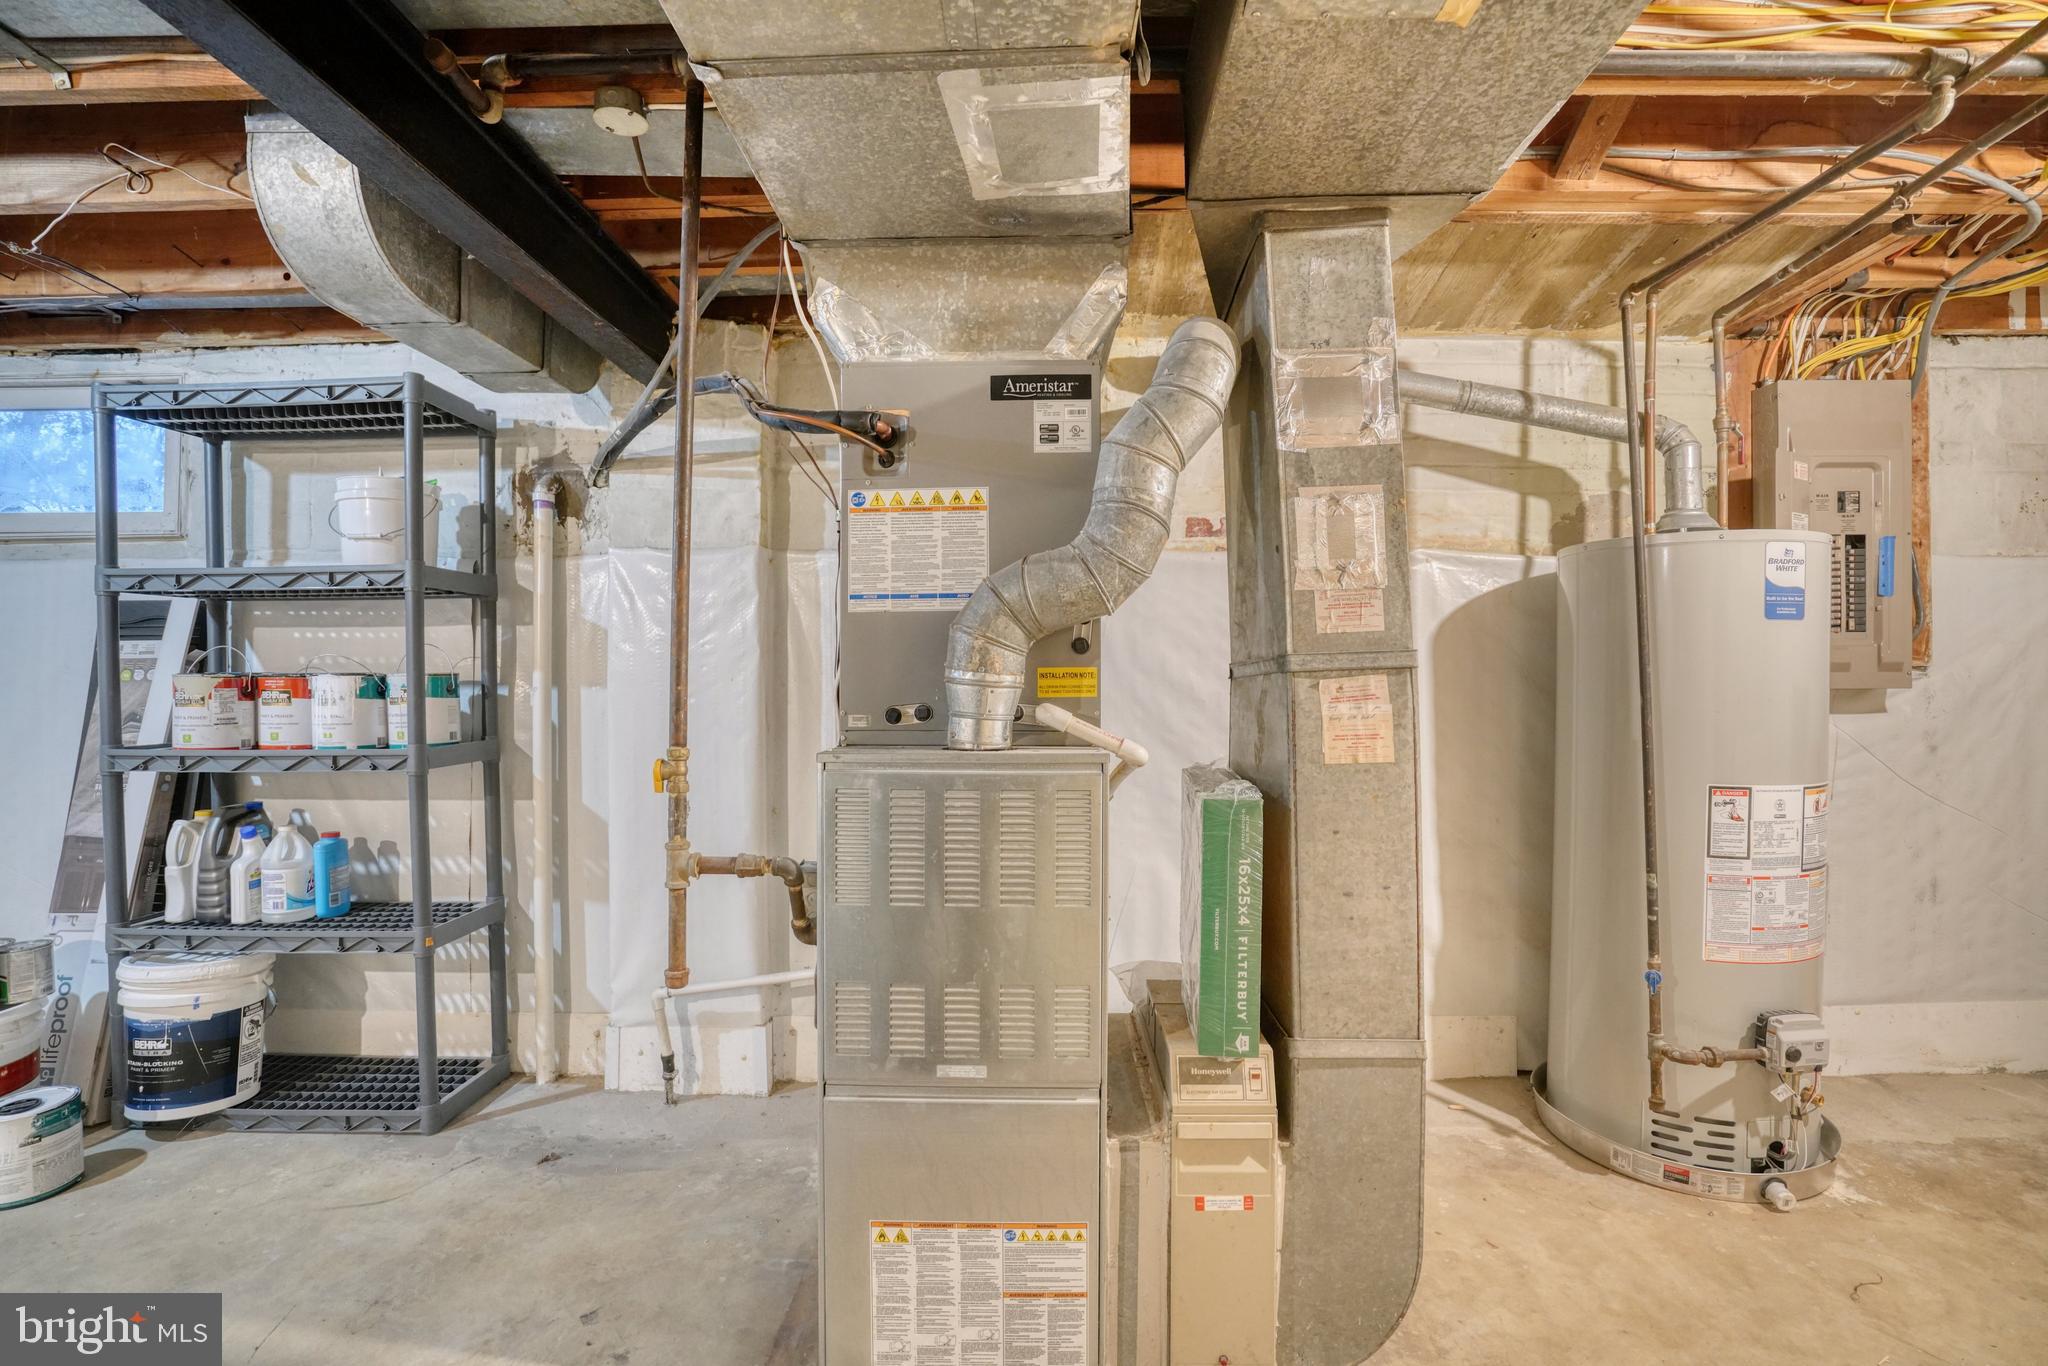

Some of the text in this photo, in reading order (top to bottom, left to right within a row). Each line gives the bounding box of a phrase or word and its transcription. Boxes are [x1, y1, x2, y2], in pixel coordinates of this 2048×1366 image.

[1003, 378, 1074, 392] Ameristar
[1238, 858, 1251, 926] 16x25x4
[1237, 936, 1248, 1020] FILTERBUY
[40, 974, 73, 1064] lifeproof
[134, 1040, 157, 1050] BEHR
[1191, 1068, 1232, 1076] Honeywell
